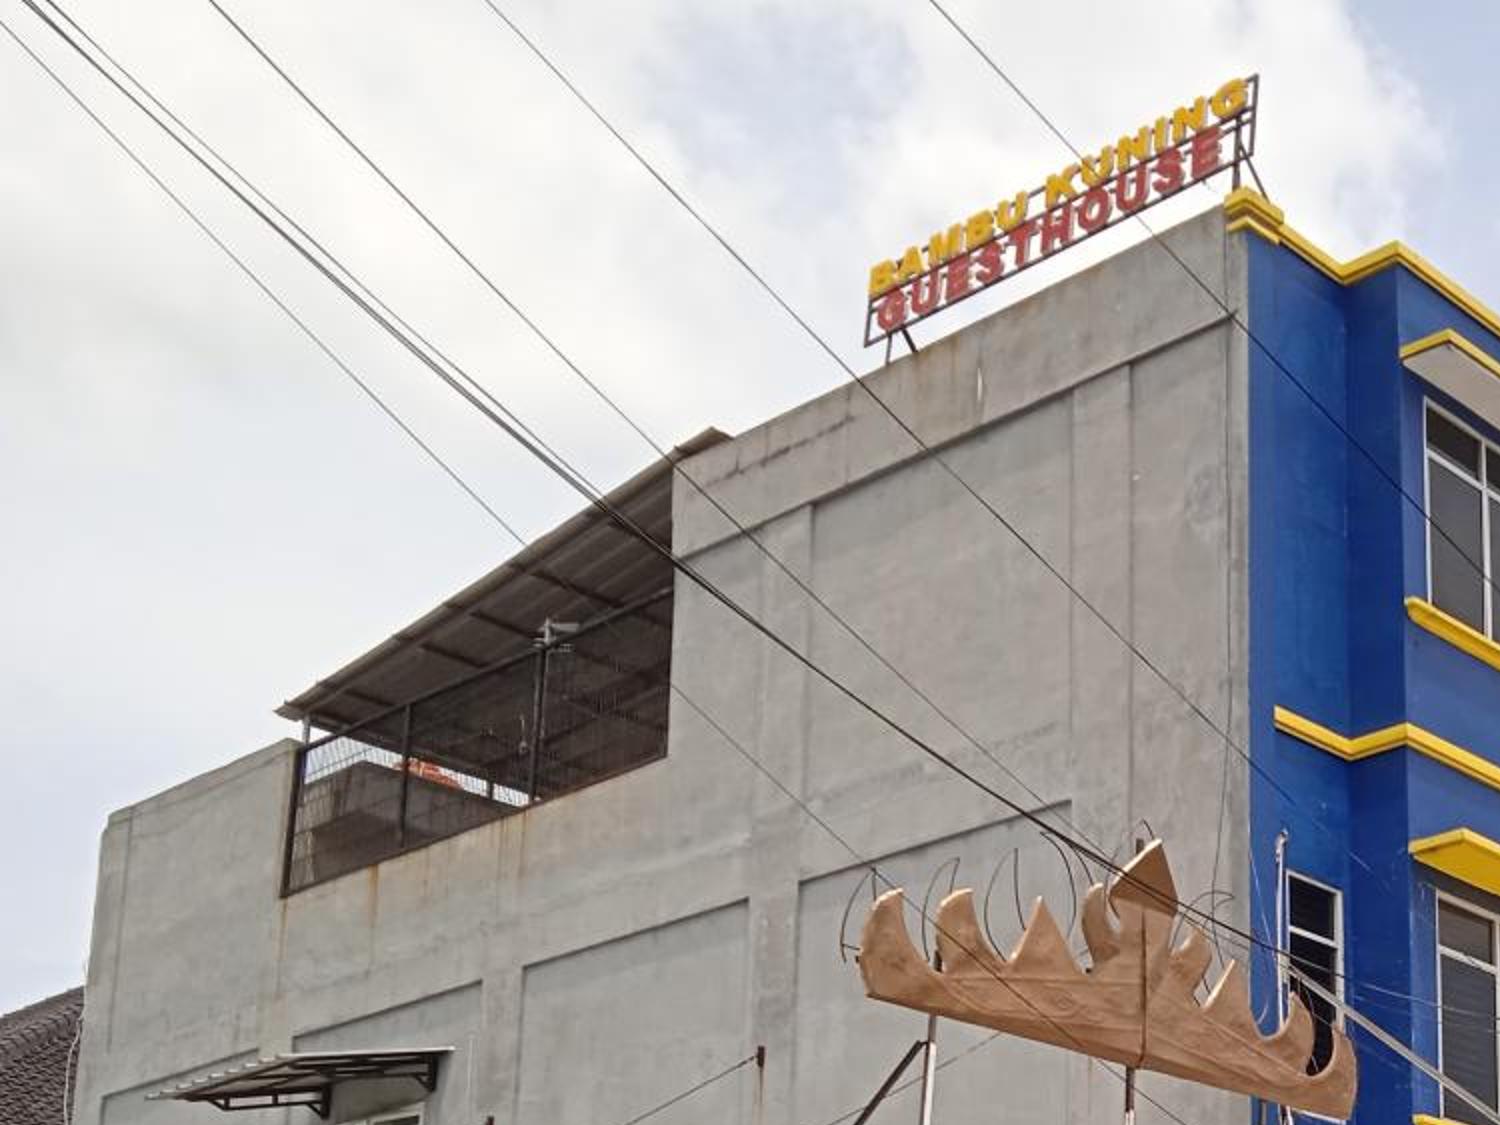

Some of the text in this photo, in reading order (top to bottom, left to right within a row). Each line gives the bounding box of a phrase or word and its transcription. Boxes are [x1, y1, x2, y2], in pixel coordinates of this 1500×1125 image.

[868, 77, 1250, 299] BAMBU KUNING
[877, 126, 1225, 332] GUESTHOUSE
